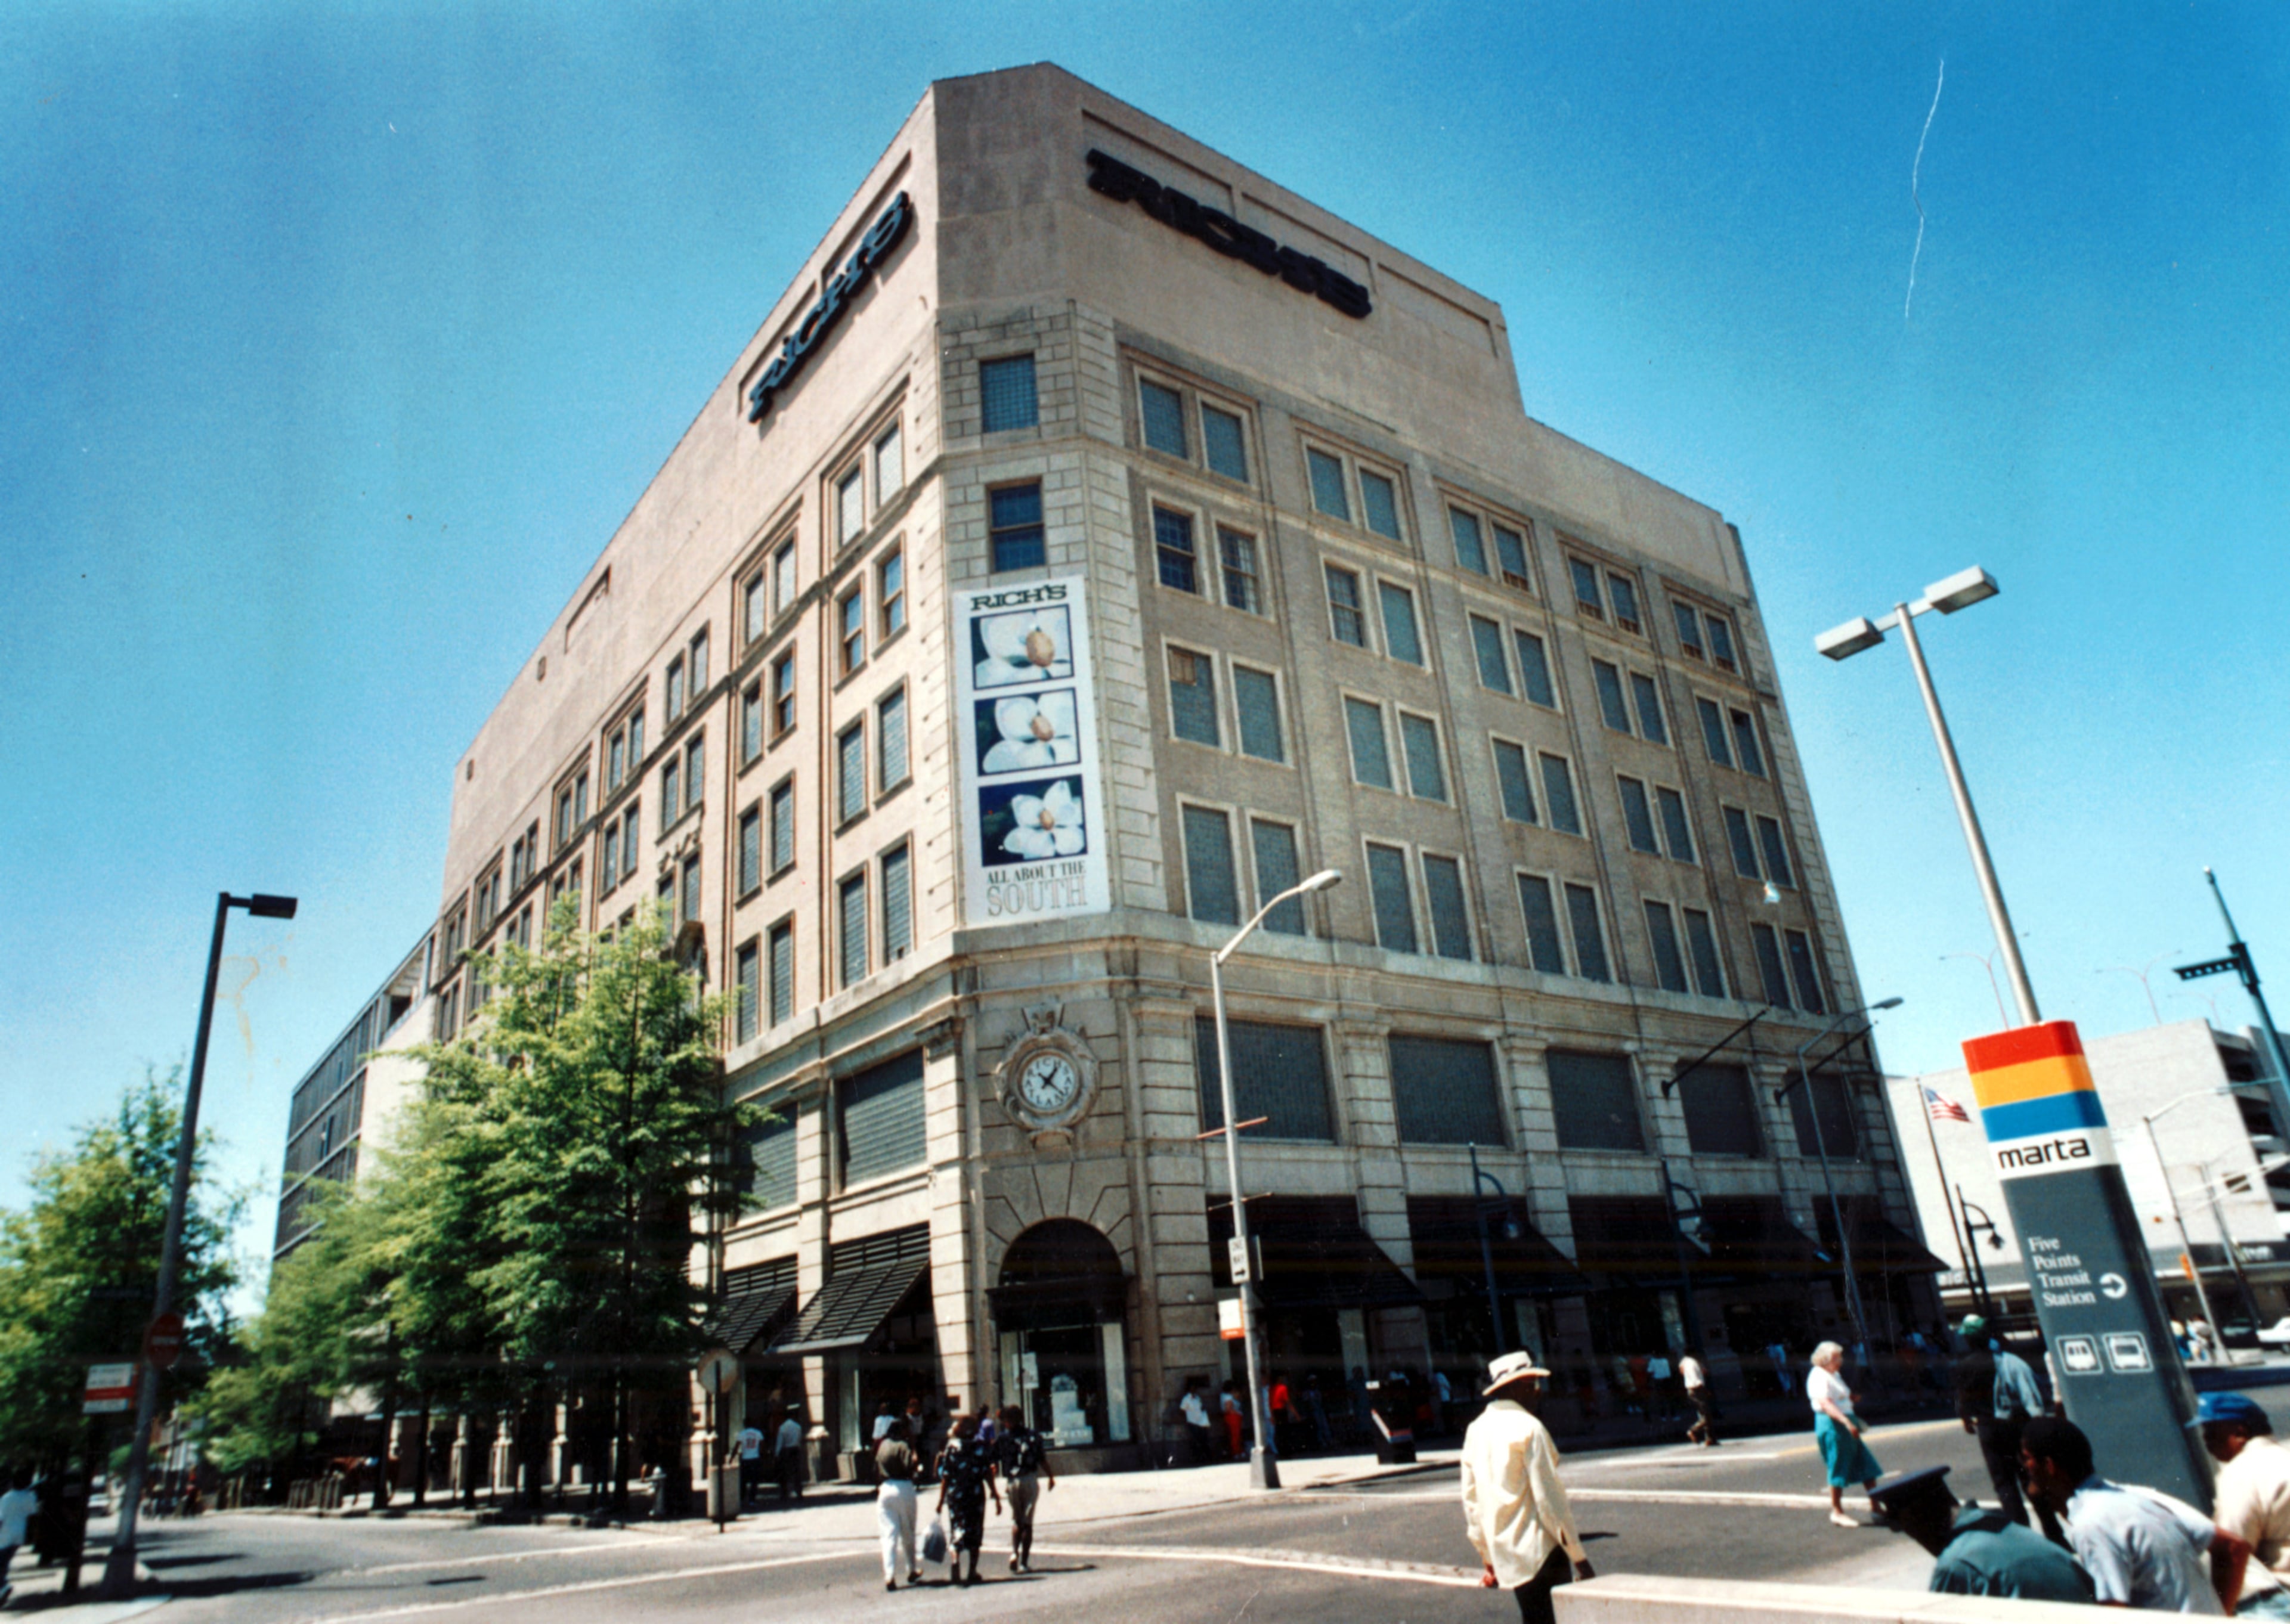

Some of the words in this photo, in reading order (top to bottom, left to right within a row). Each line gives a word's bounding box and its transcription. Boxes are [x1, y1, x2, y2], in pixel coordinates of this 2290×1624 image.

[970, 584, 1067, 611] RICH'S
[987, 869, 1010, 885] ALL
[1014, 864, 1056, 882] ABOUT
[1060, 861, 1086, 876] THE
[986, 876, 1088, 917] SOUTH
[1998, 1138, 2091, 1169] marta
[2028, 1236, 2060, 1251] Five
[2032, 1254, 2081, 1270] Points
[2037, 1269, 2091, 1288] Transit
[2041, 1290, 2097, 1307] Station
